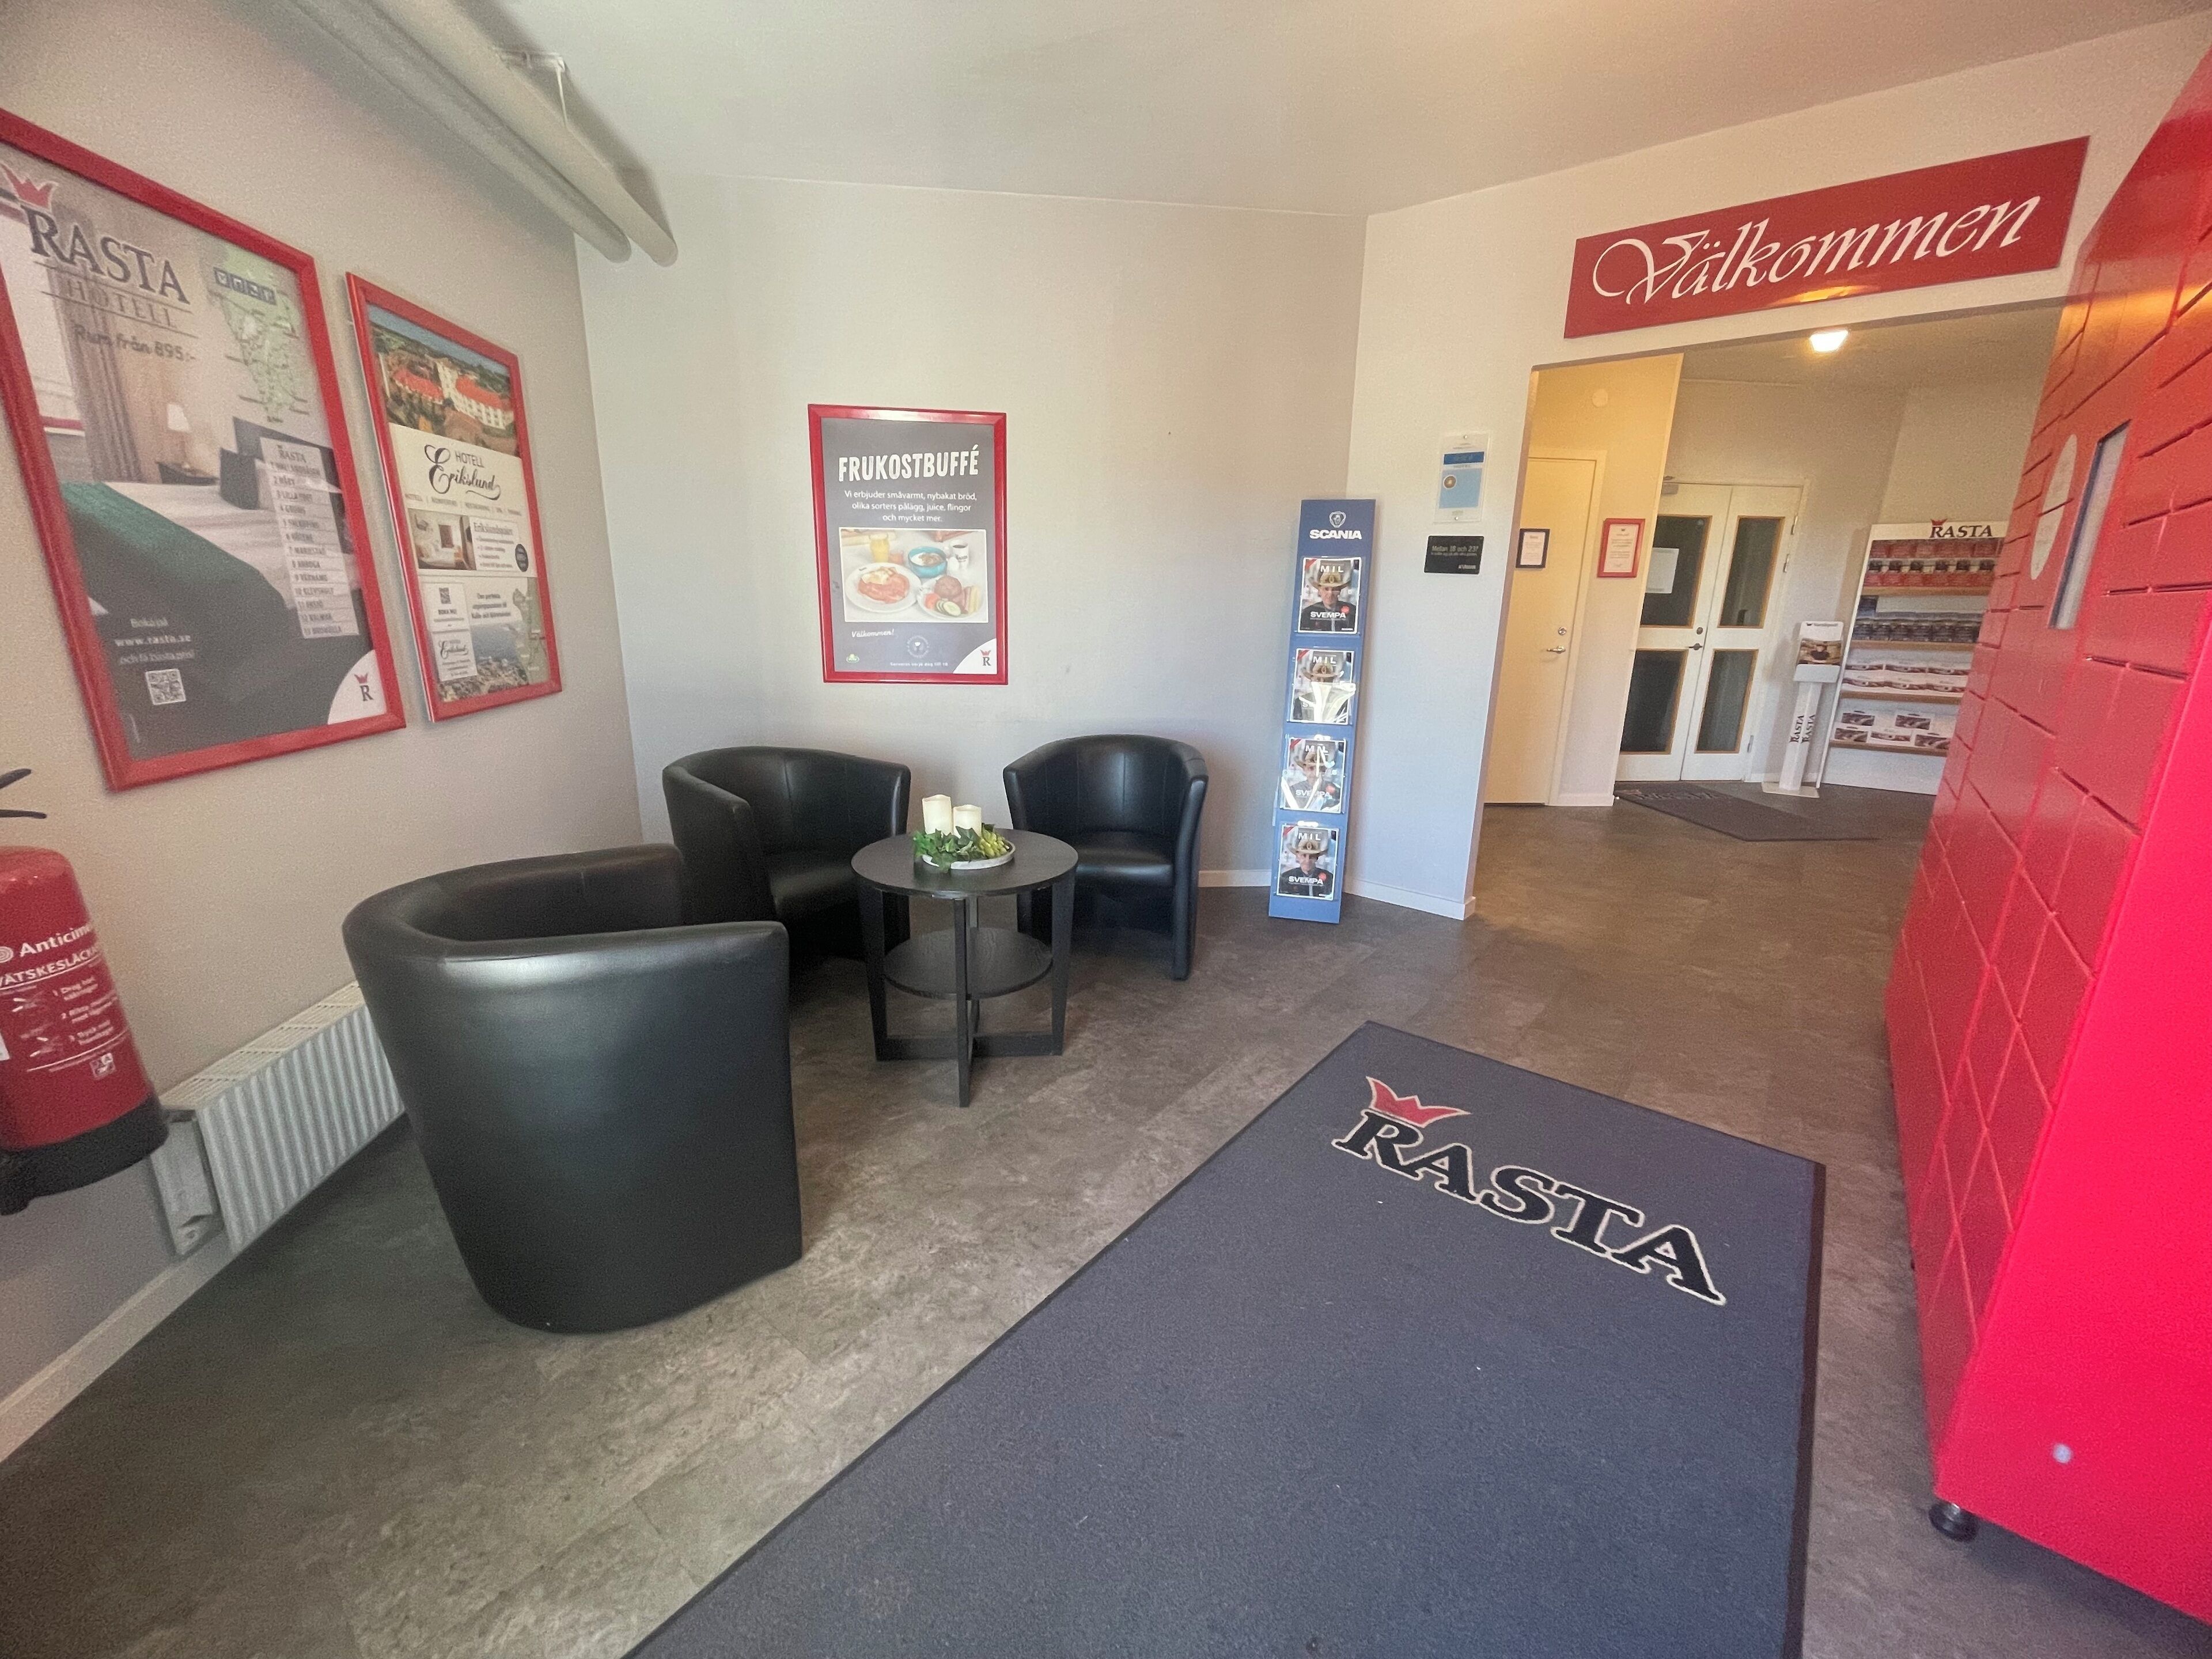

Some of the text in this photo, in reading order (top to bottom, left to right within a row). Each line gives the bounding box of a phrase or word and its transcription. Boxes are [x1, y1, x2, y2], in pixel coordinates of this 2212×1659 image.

[20, 204, 191, 305] RASTA
[1593, 195, 2041, 305] Välkommen
[454, 450, 485, 468] HOTELL
[839, 444, 979, 482] FRUKOSTBUFFÉ
[424, 444, 501, 501] Erikslund
[854, 491, 885, 499] erbjuder
[887, 491, 926, 500] småvarmt,
[927, 492, 956, 501] nybakat
[958, 493, 978, 501] bröd,
[852, 502, 870, 510] olika
[898, 502, 925, 512] pålägg,
[926, 503, 946, 512] juice,
[947, 503, 971, 513] flingor
[882, 513, 897, 522] och
[898, 514, 925, 523] mycket
[1309, 529, 1362, 540] SCANIA
[1929, 525, 1993, 539] RASTA
[1320, 565, 1344, 573] MIL
[851, 628, 895, 638] Välkommen!
[982, 656, 991, 666] R
[1313, 656, 1336, 664] MIL
[360, 685, 373, 702] R
[1298, 832, 1321, 840] MIL
[1289, 876, 1324, 885] SVEMPA
[1331, 1108, 1727, 1306] RASTA
